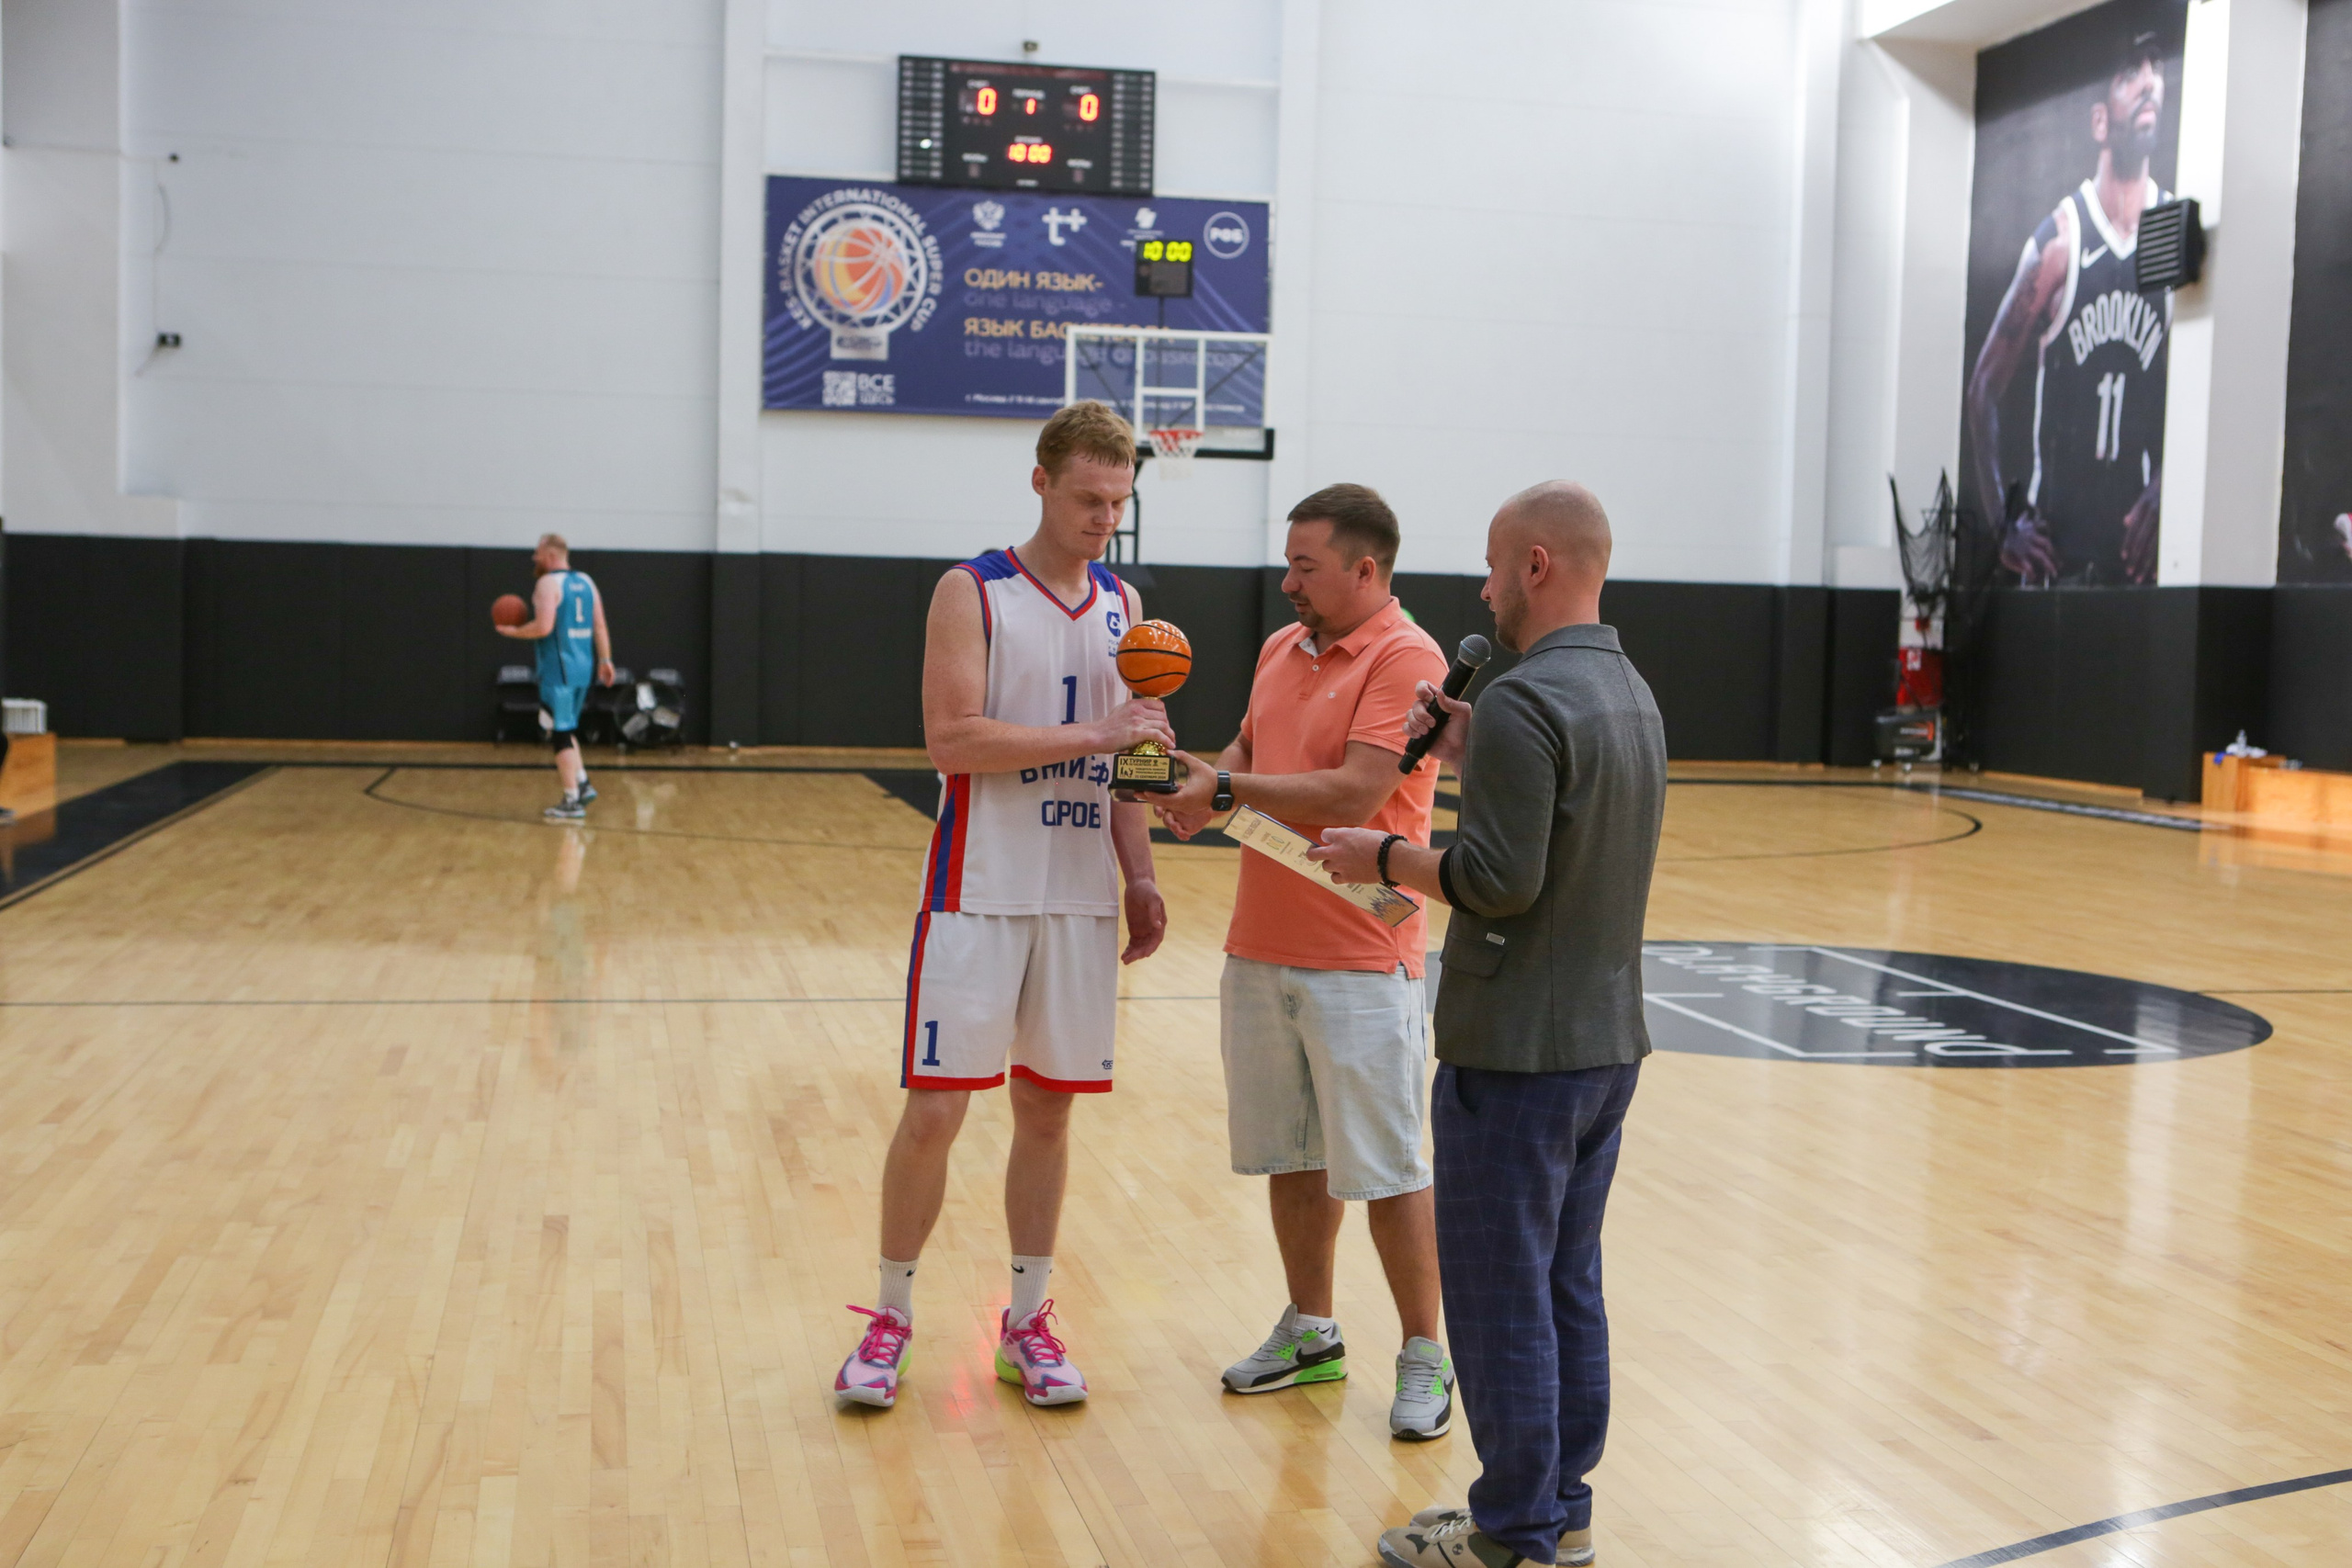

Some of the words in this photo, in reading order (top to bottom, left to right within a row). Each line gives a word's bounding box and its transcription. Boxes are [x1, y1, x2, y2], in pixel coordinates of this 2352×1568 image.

[978, 87, 997, 115] 0
[1026, 97, 1035, 115] 1
[1080, 94, 1099, 121] 0
[797, 187, 927, 236] INTERNATIONAL
[922, 234, 944, 295] SUPER
[965, 268, 1030, 289] ОДИН
[1035, 272, 1103, 291] ЯЗЫК-
[910, 298, 937, 332] CUP
[965, 293, 1006, 307] one
[1012, 291, 1112, 318] language
[965, 318, 1023, 337] ЯЗЫК
[2068, 290, 2163, 371] BROOKLYN
[965, 340, 1001, 357] the
[2097, 372, 2125, 461] 11
[575, 596, 584, 622] 1
[1060, 675, 1079, 725] 1
[1041, 800, 1101, 829] СРОВ
[1643, 946, 2073, 1057] PLAYGROUND
[922, 1021, 940, 1066] 1
